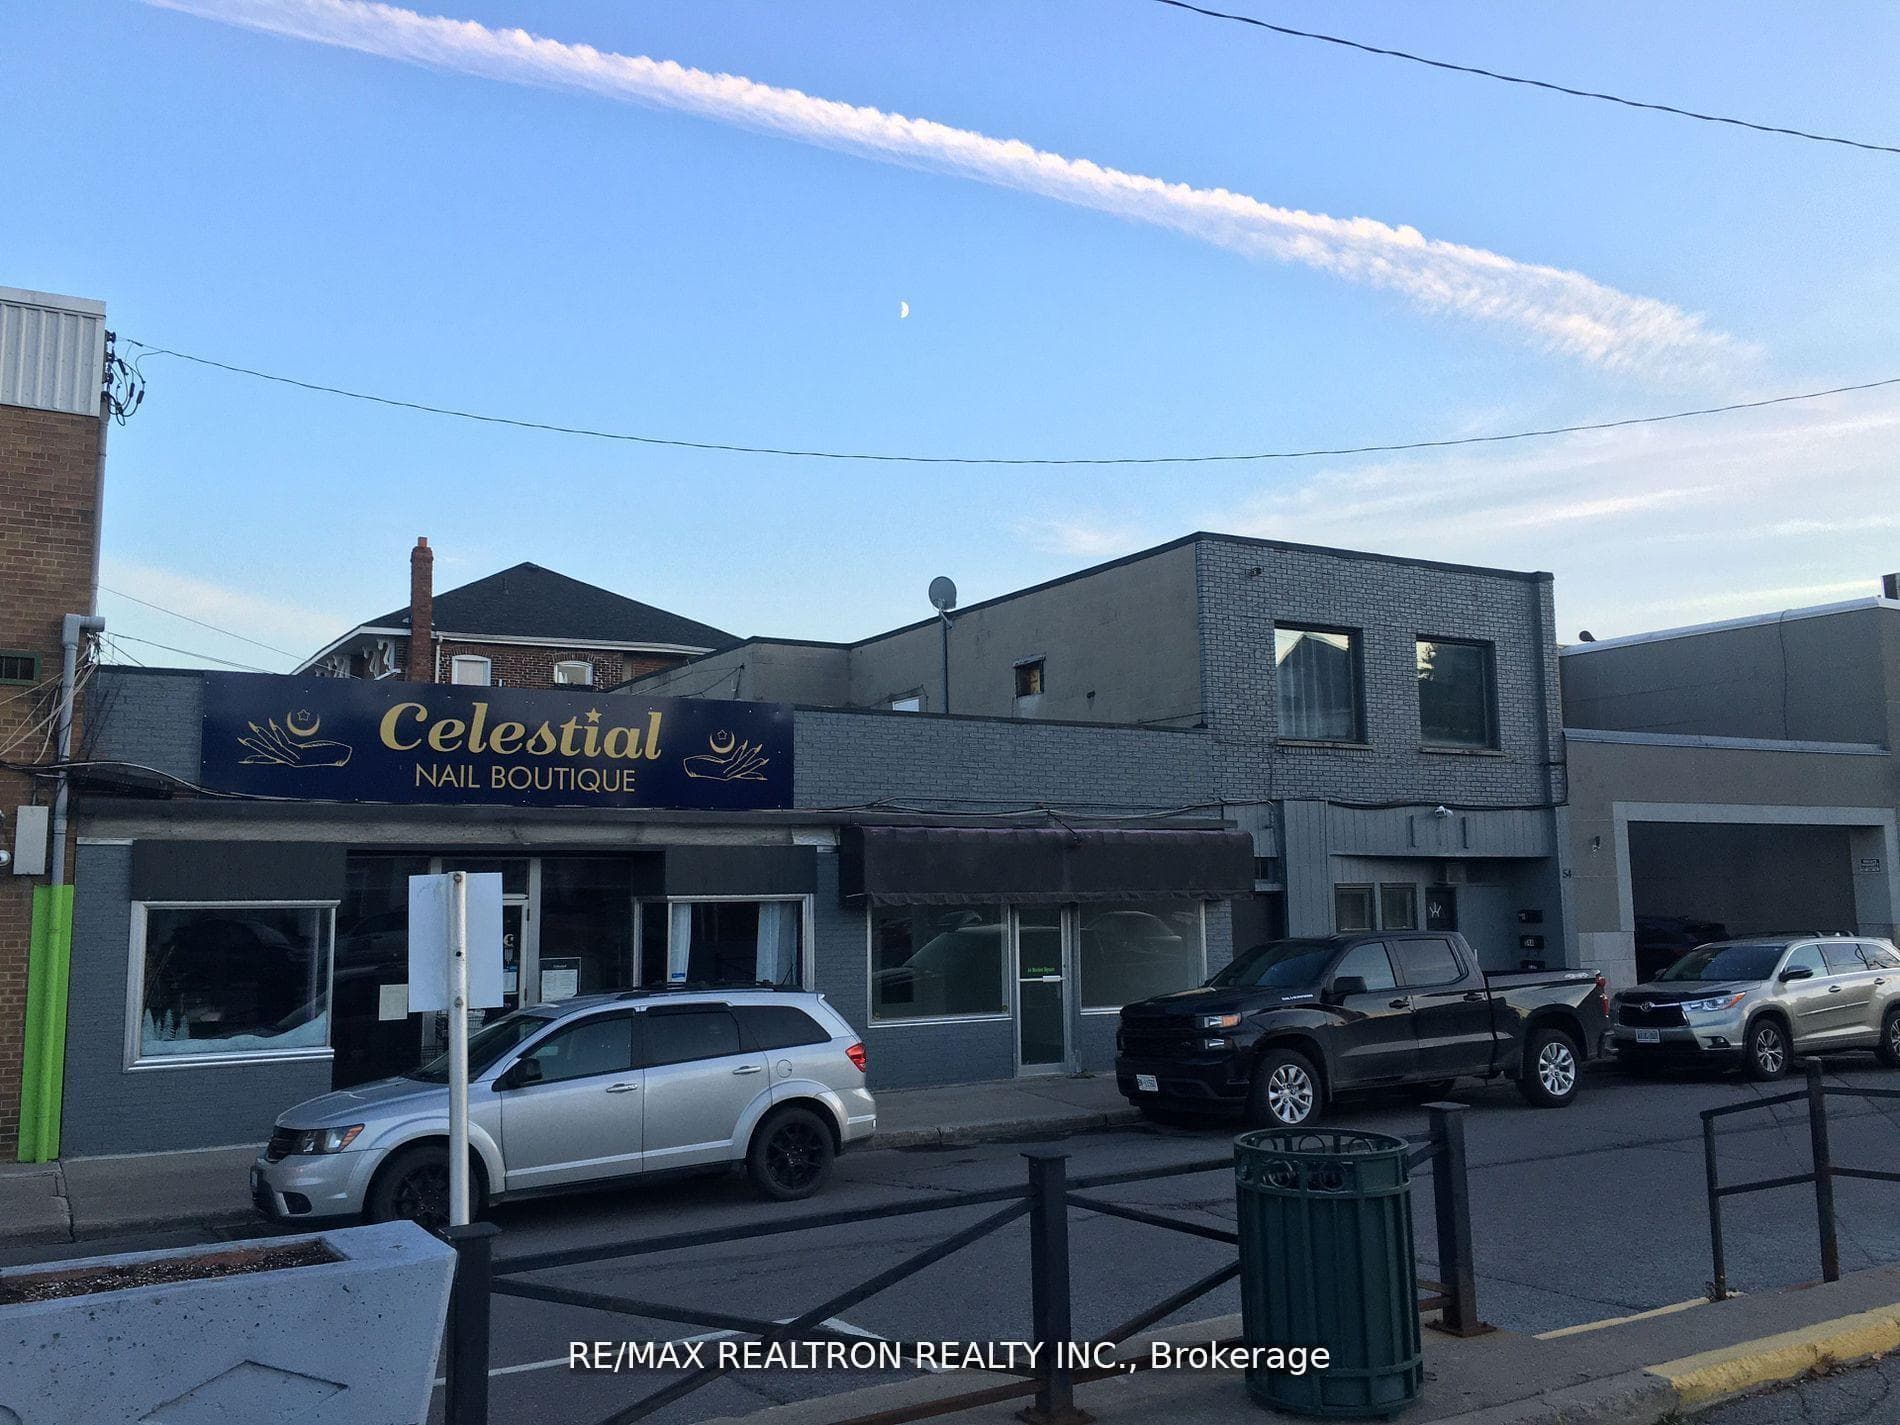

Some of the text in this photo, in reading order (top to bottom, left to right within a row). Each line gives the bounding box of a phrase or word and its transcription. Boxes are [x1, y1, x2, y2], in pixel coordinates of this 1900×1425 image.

[379, 701, 663, 761] Celestial
[414, 762, 636, 793] NAIL BOUTIQUE
